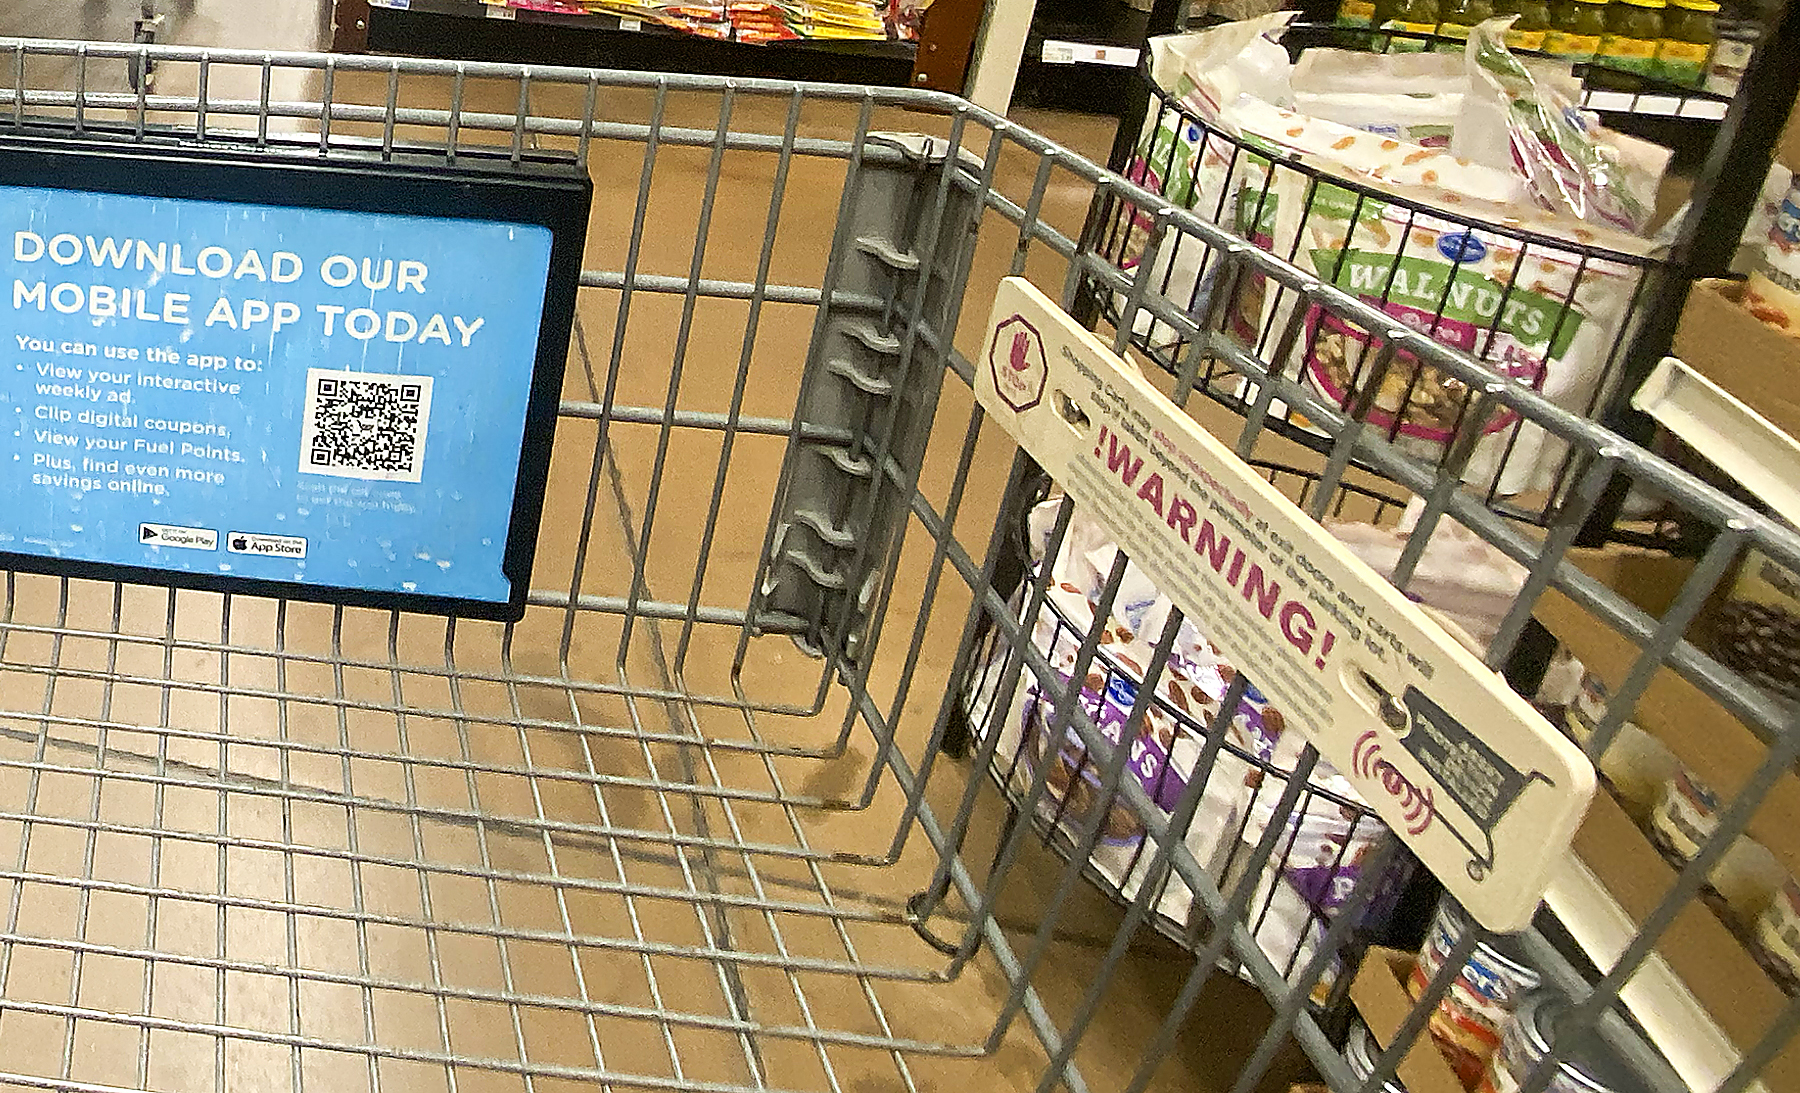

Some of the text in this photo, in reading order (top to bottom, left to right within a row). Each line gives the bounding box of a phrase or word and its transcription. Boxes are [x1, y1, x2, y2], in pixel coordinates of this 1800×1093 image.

[13, 230, 429, 295] DOWNLOAD OUR
[12, 279, 485, 349] MOBILE APP TODAY
[1350, 264, 1545, 335] WALNUTS
[16, 335, 263, 372] You can use the app to:
[35, 382, 101, 402] weekly
[36, 363, 241, 395] View your interactive
[35, 405, 71, 423] Clip
[78, 409, 138, 428] digital
[34, 429, 246, 463] View your Fuel Points.
[32, 472, 169, 496] savings online.
[33, 453, 225, 485] Plus, find even more
[161, 533, 214, 548] Google Play
[251, 541, 302, 554] App Store
[1094, 425, 1336, 671] !WARNING!
[1297, 552, 1333, 592] doors
[1340, 588, 1363, 618] and
